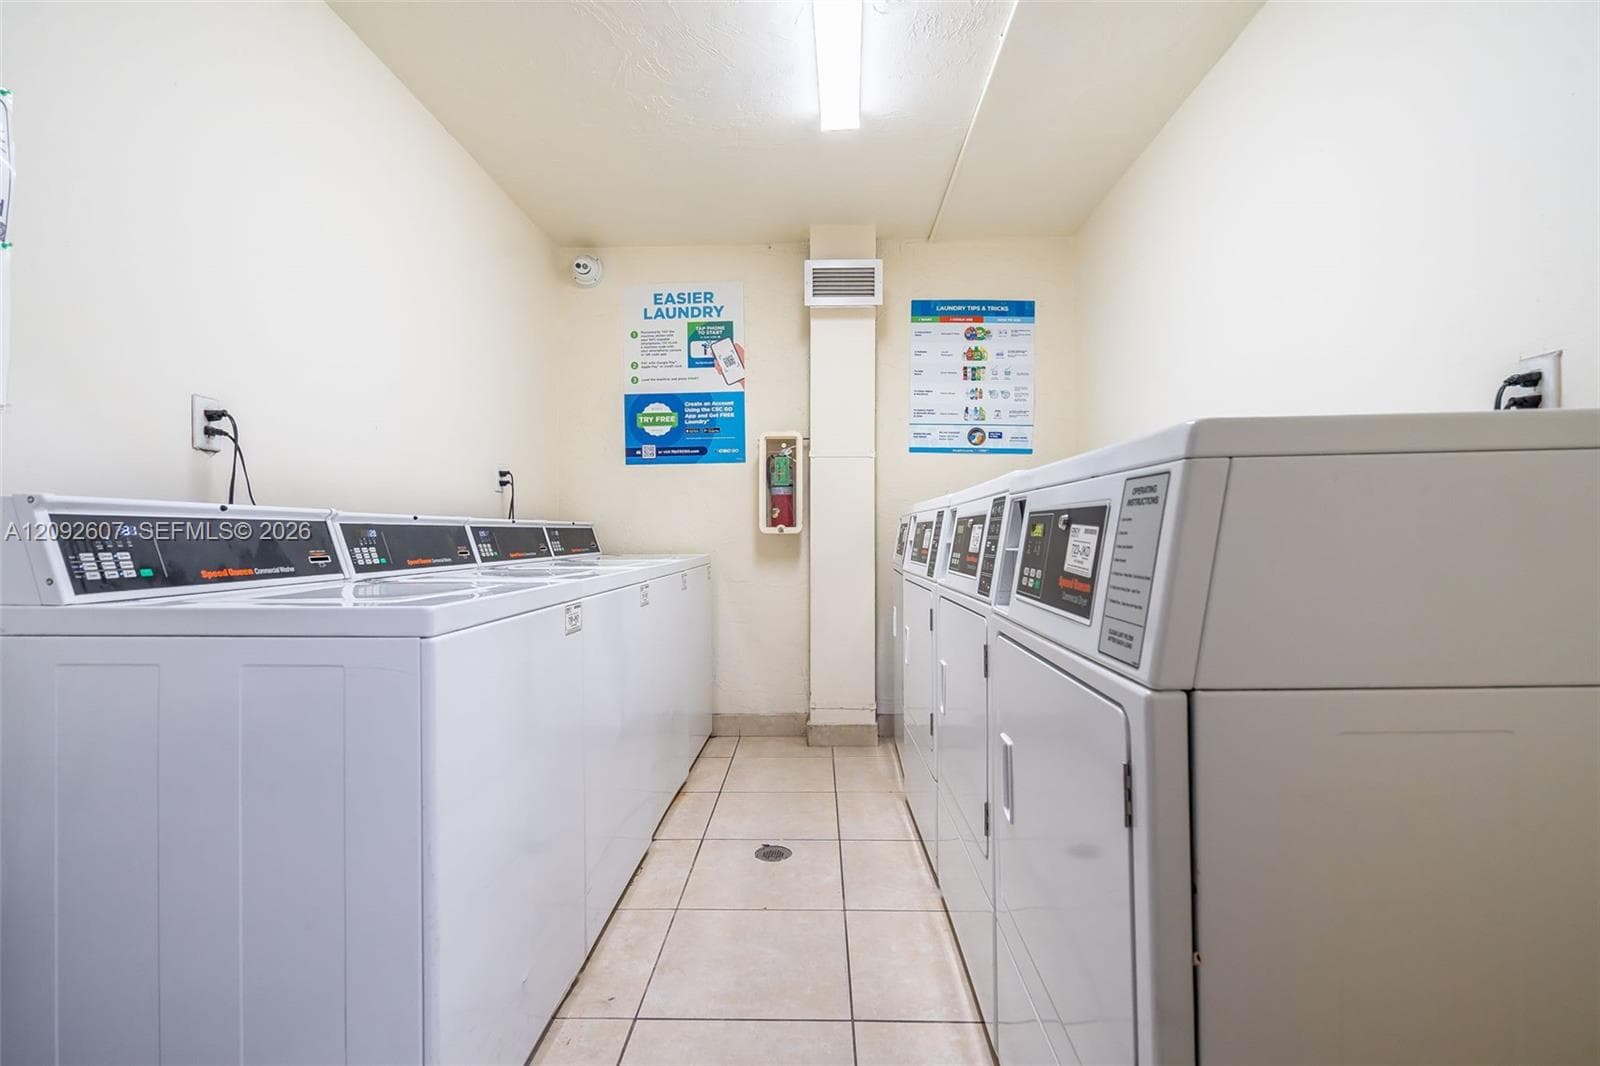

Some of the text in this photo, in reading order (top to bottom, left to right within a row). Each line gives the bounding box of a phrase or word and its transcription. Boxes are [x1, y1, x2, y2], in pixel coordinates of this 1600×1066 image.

[653, 291, 714, 306] EASIER
[643, 305, 725, 320] LAUNDRY
[639, 415, 676, 423] TRY FREE
[1131, 484, 1158, 496] OPERATING
[1126, 496, 1160, 506] INSTRUCTIONS
[200, 568, 228, 580] Speed
[228, 568, 254, 576] Queen
